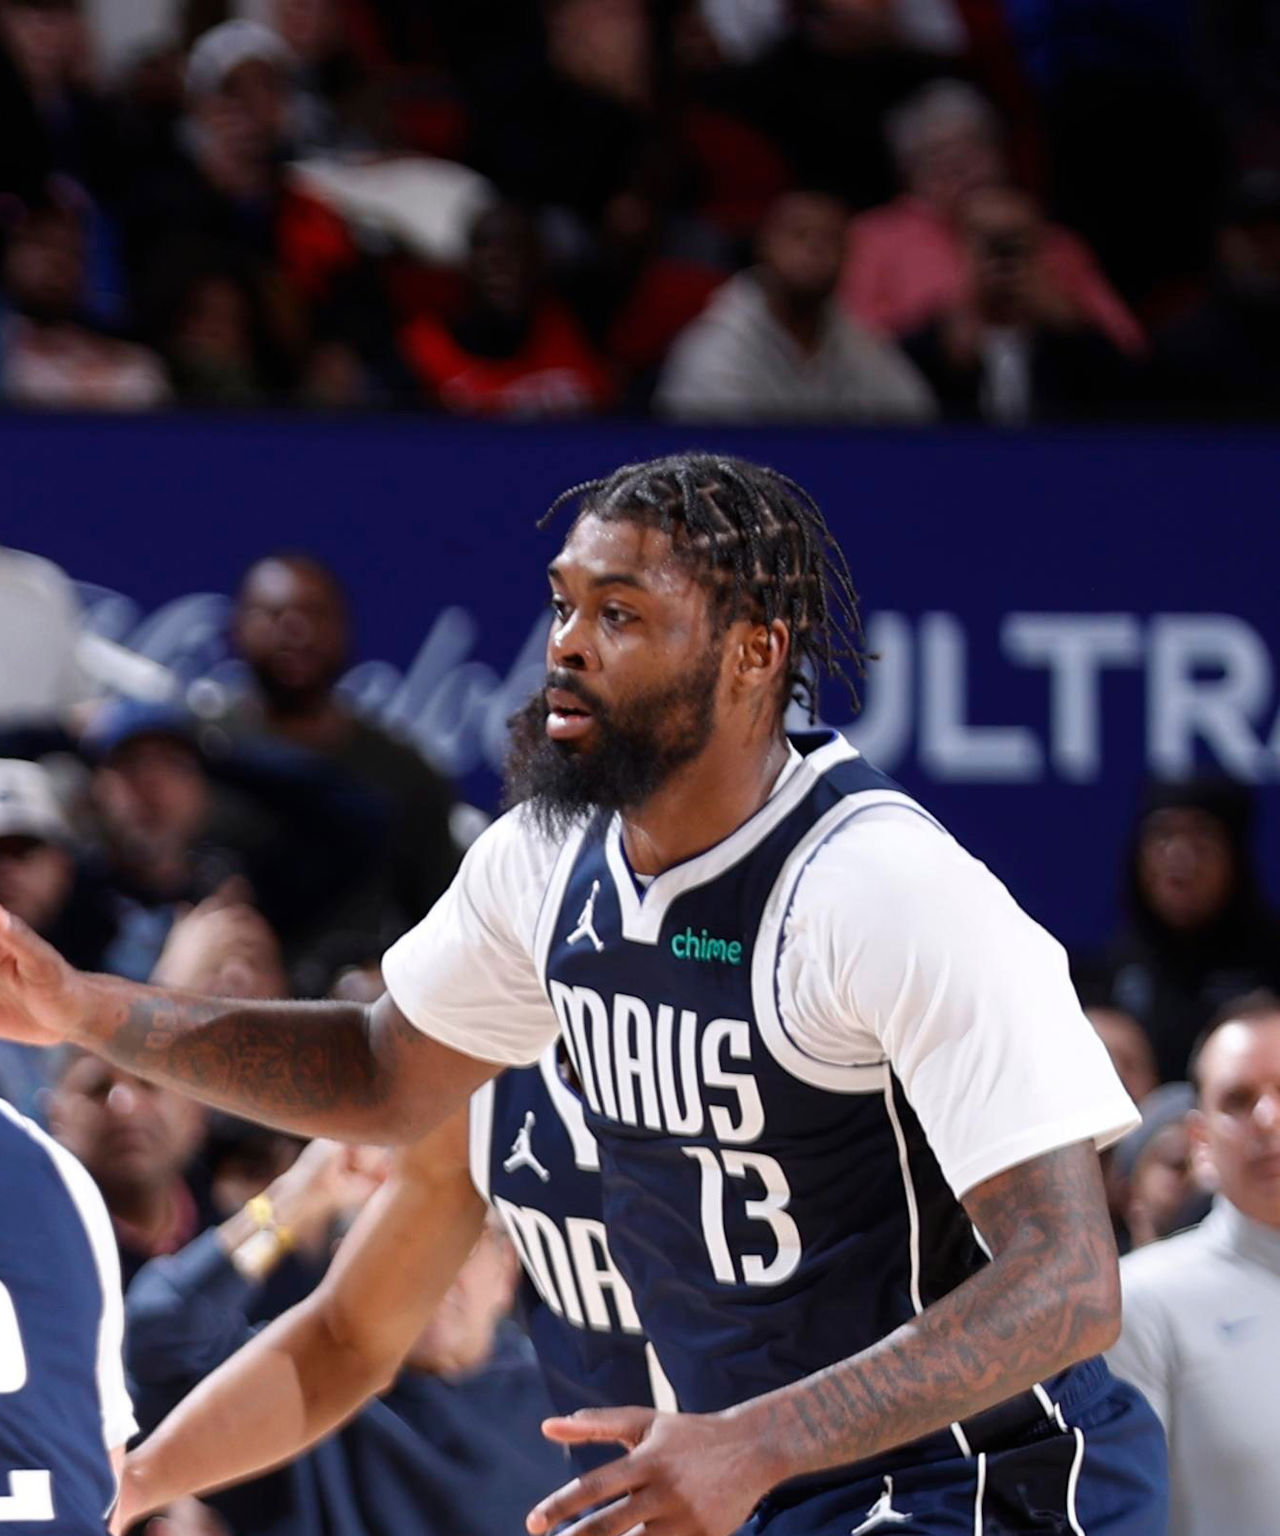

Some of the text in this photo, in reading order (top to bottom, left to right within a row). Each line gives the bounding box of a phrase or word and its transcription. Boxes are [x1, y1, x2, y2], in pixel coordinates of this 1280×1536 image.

[786, 610, 1280, 785] ULTR
[670, 927, 742, 966] chime
[549, 979, 766, 1145] MAVS
[492, 1195, 644, 1333] MA
[680, 1146, 802, 1287] 13
